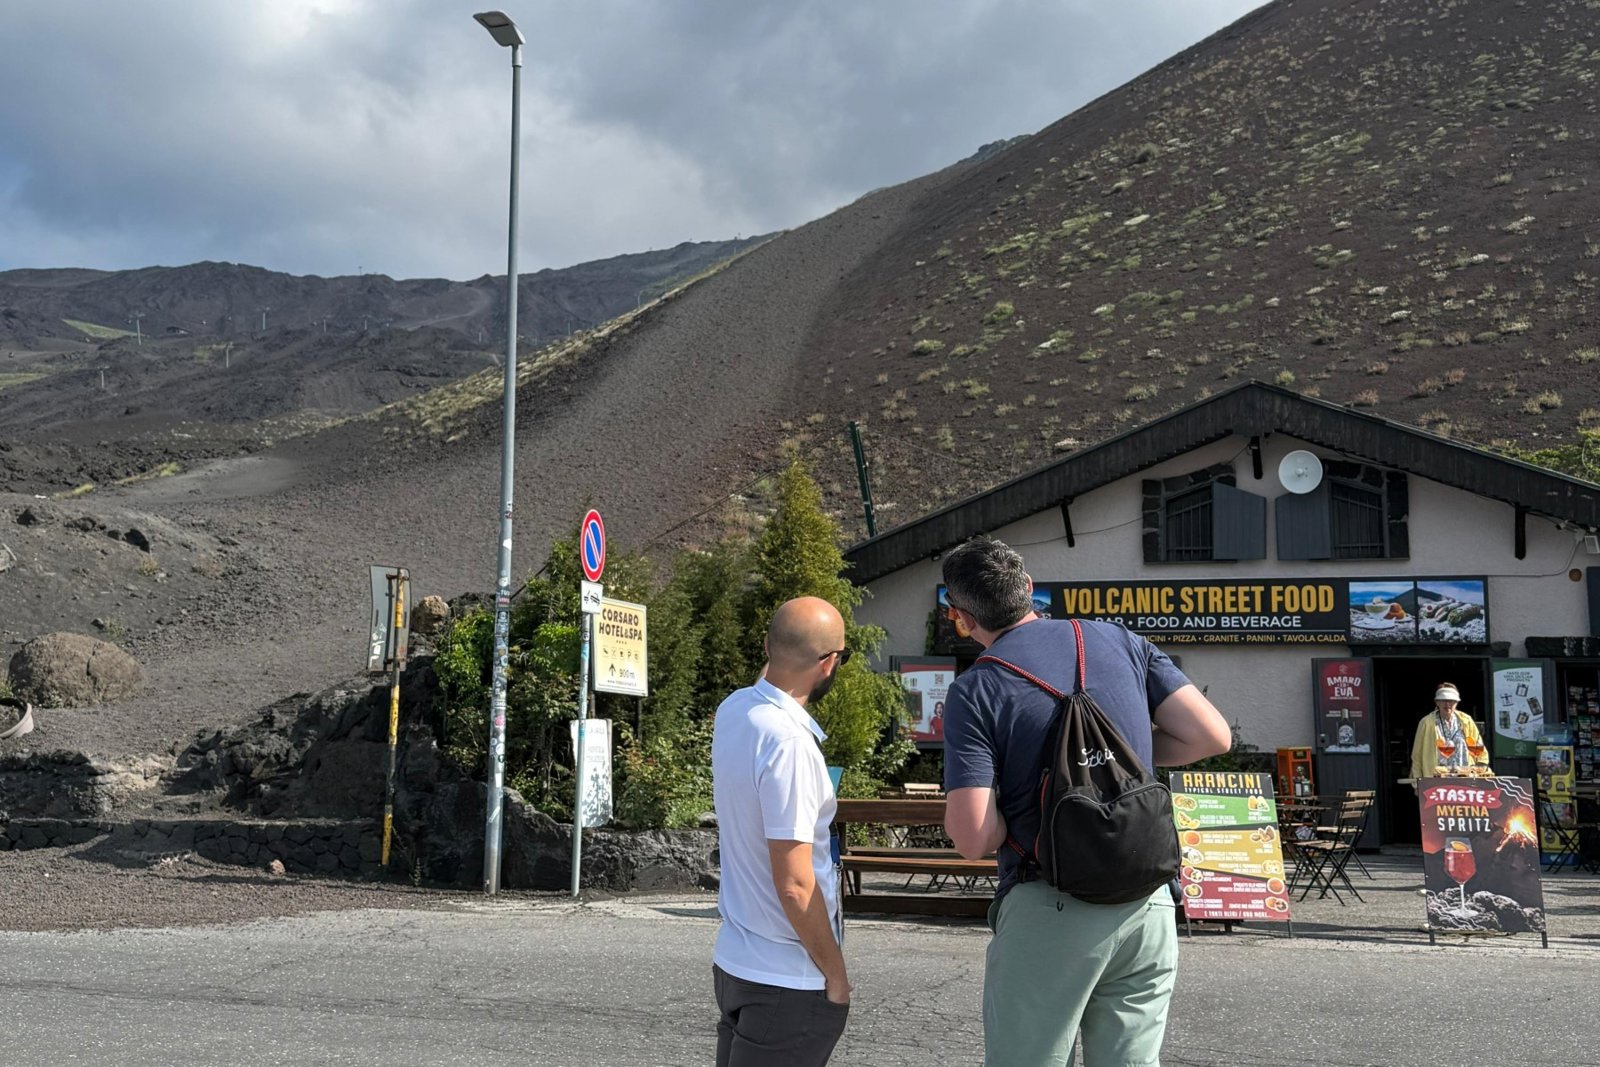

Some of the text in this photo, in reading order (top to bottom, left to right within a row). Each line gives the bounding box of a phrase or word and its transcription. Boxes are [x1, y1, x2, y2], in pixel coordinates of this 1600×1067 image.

[1063, 585, 1335, 615] VOLCANIC STREET FOOD
[602, 608, 639, 626] CORSARO
[1137, 616, 1180, 628] FOOD
[1183, 616, 1217, 628] AND
[1221, 616, 1302, 627] BEVERAGE
[1173, 635, 1197, 643] PIZZA
[1203, 634, 1239, 642] GRANITE
[1246, 634, 1276, 642] PANINI
[1283, 634, 1315, 642] TAVOLA
[1316, 634, 1347, 642] CALDA
[1326, 676, 1361, 687] AMARO
[1183, 773, 1261, 789] ARANCINI
[1436, 788, 1485, 803] TASTE
[1436, 805, 1489, 817] MYETNA
[1437, 817, 1491, 832] SPRITZ
